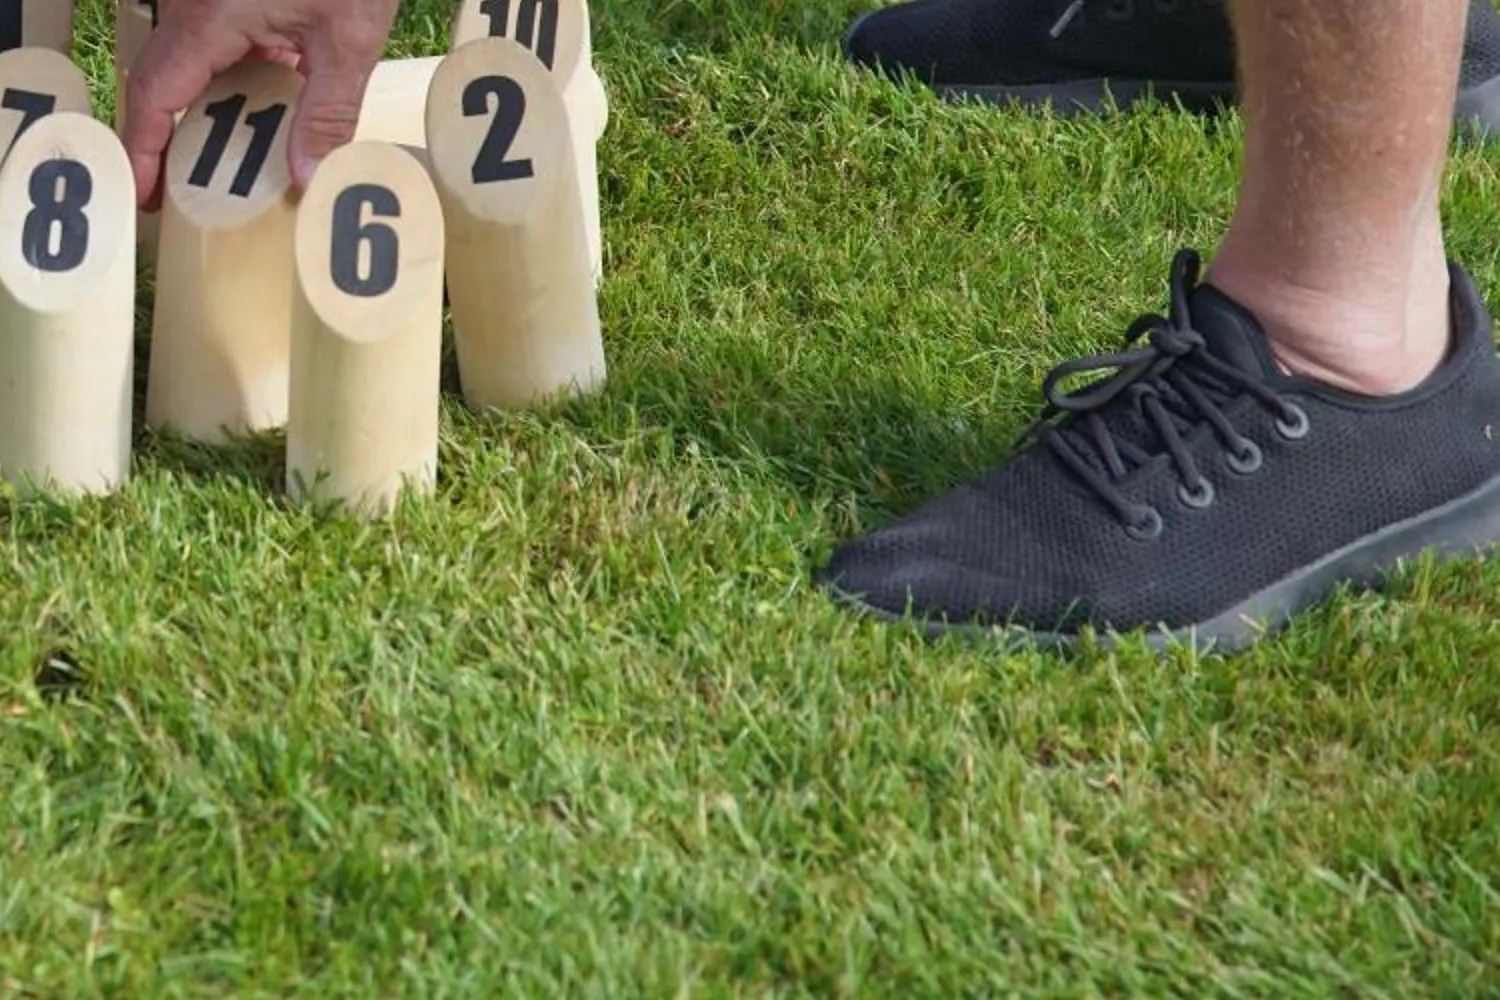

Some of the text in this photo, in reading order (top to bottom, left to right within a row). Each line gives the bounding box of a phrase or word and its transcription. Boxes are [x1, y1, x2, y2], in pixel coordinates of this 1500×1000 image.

[188, 93, 287, 198] 11
[462, 75, 534, 184] 2
[21, 159, 92, 272] 8
[330, 183, 401, 297] 6
